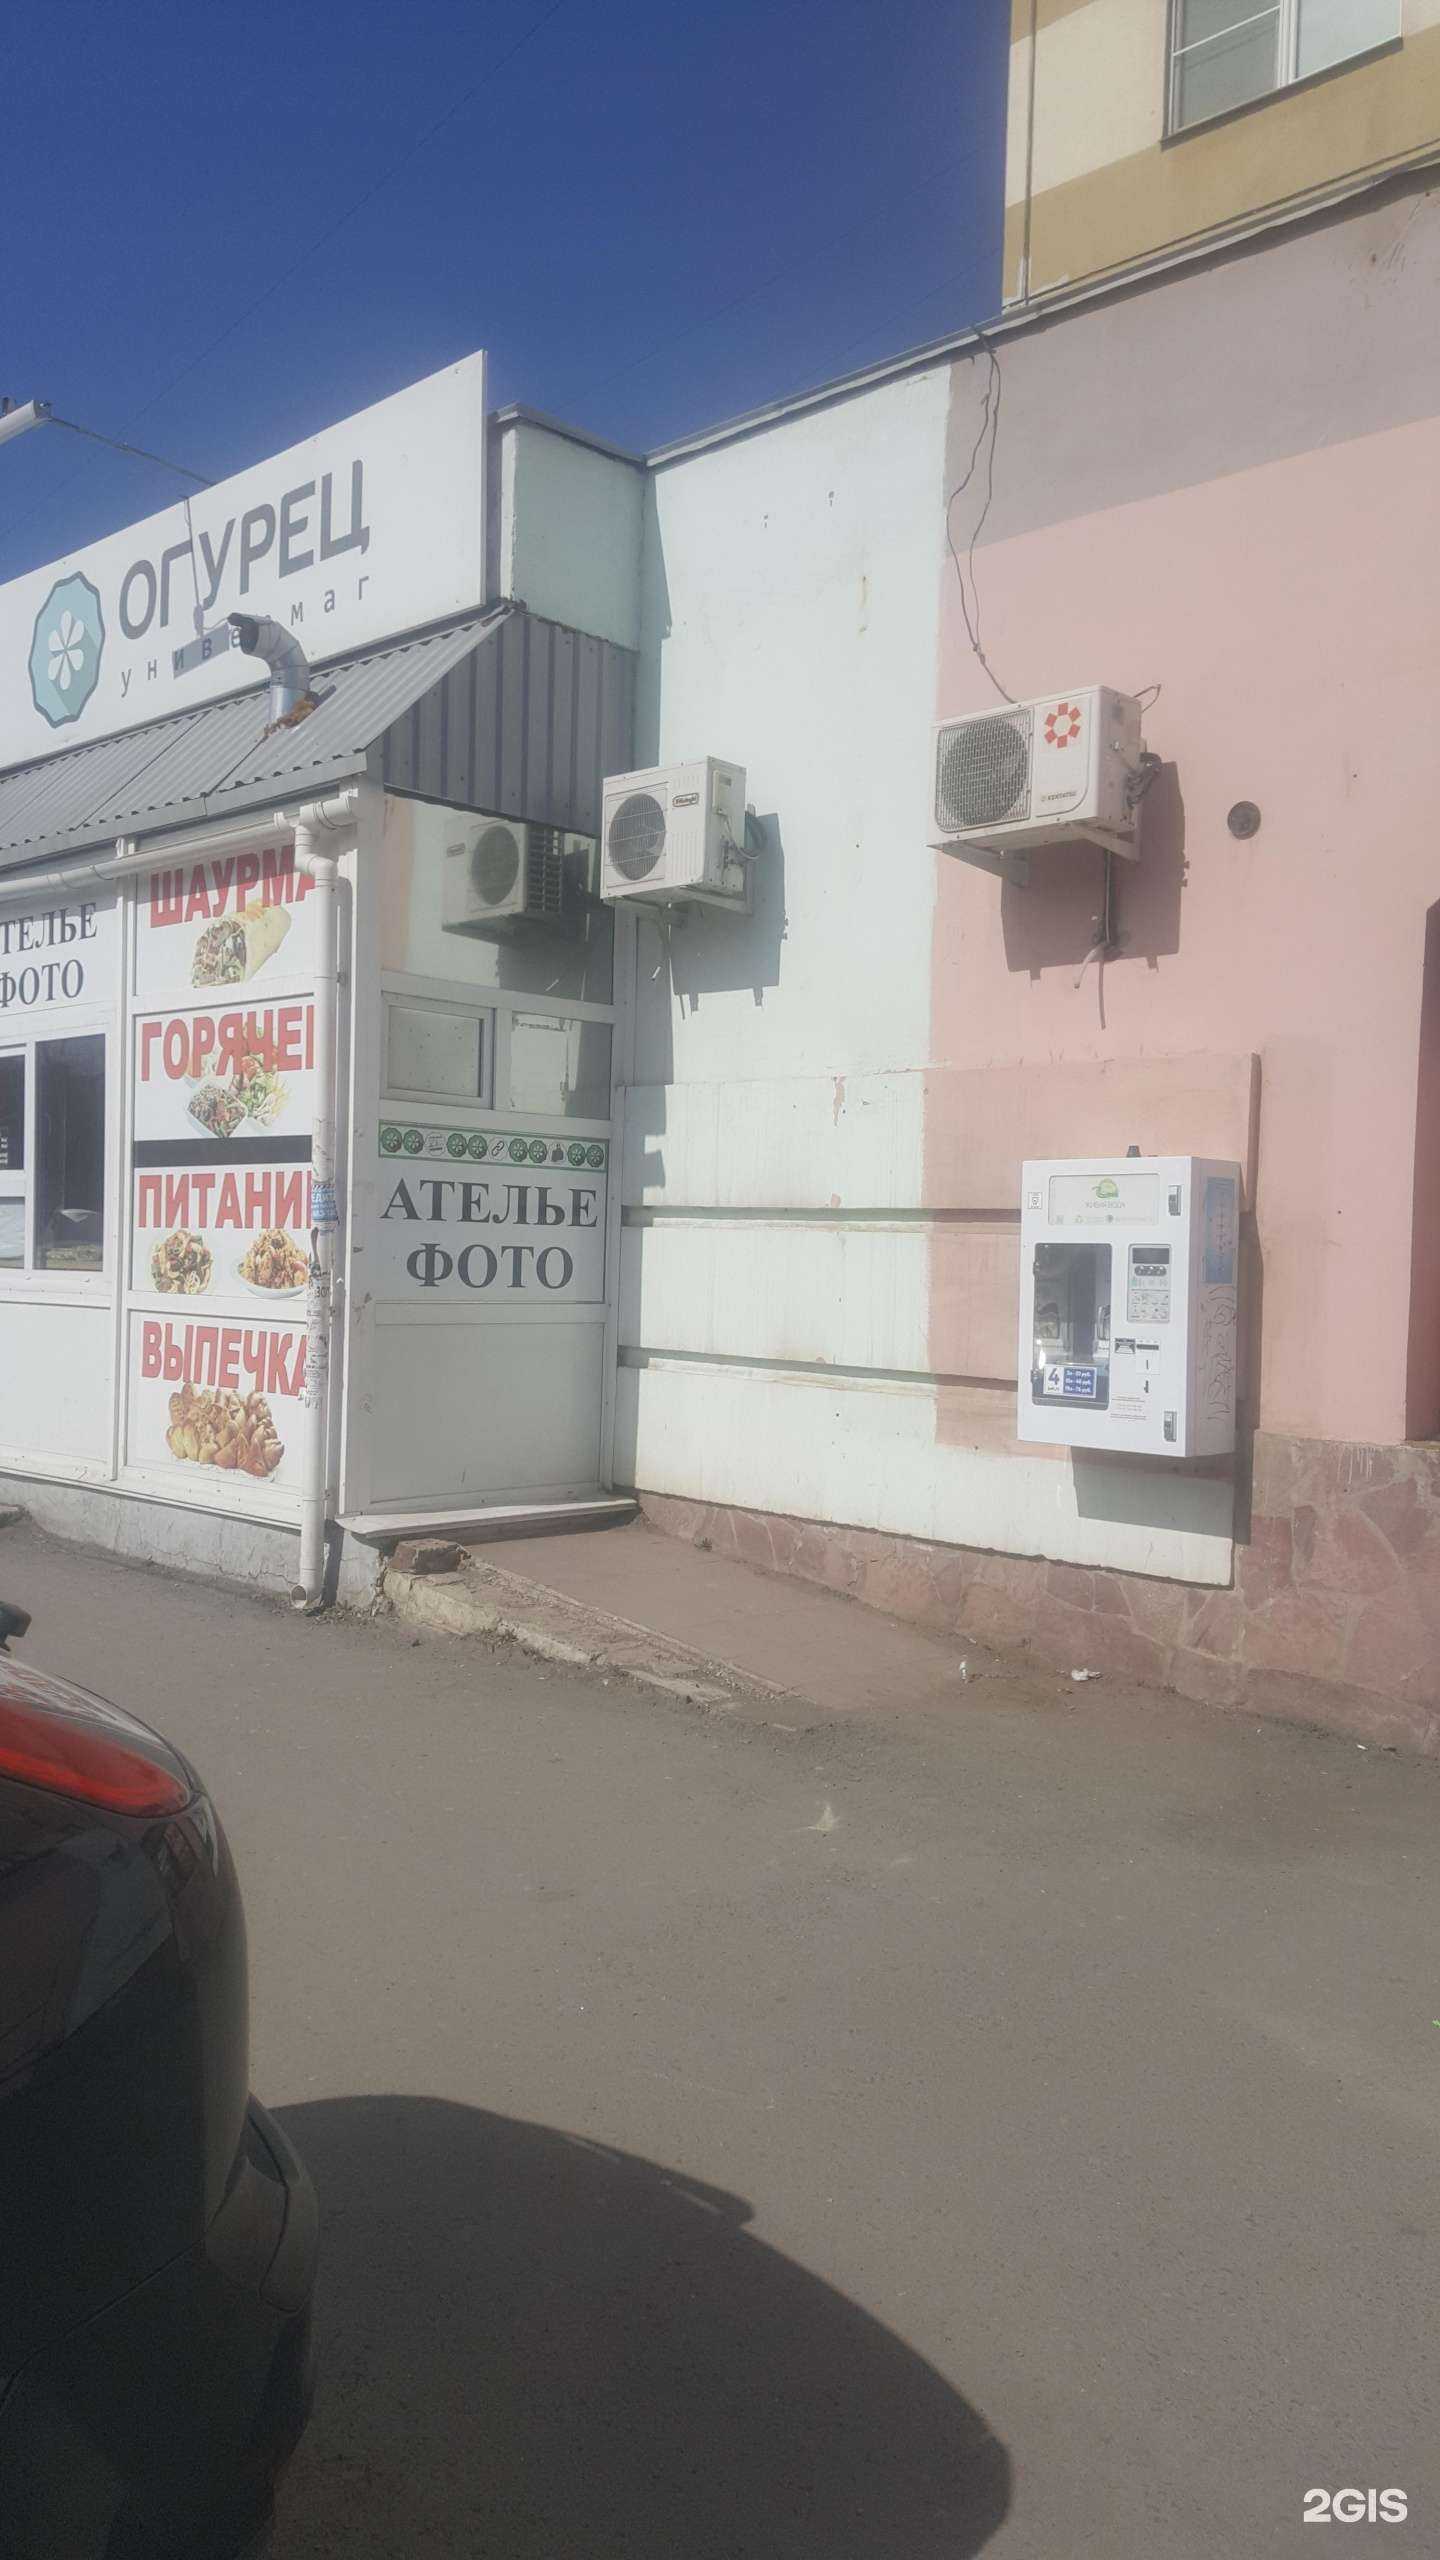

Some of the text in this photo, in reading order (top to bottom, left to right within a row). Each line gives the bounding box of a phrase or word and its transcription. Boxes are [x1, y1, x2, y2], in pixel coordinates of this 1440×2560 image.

[118, 459, 370, 640] ОГУРЕЦ
[121, 576, 369, 698] унивемаг
[0, 959, 84, 1008] ФОТО
[138, 1170, 312, 1229] ПИТАНИ
[379, 1178, 598, 1227] АТЕЛЬЕ
[406, 1243, 573, 1289] ФОТО
[1048, 1367, 1060, 1385] 4
